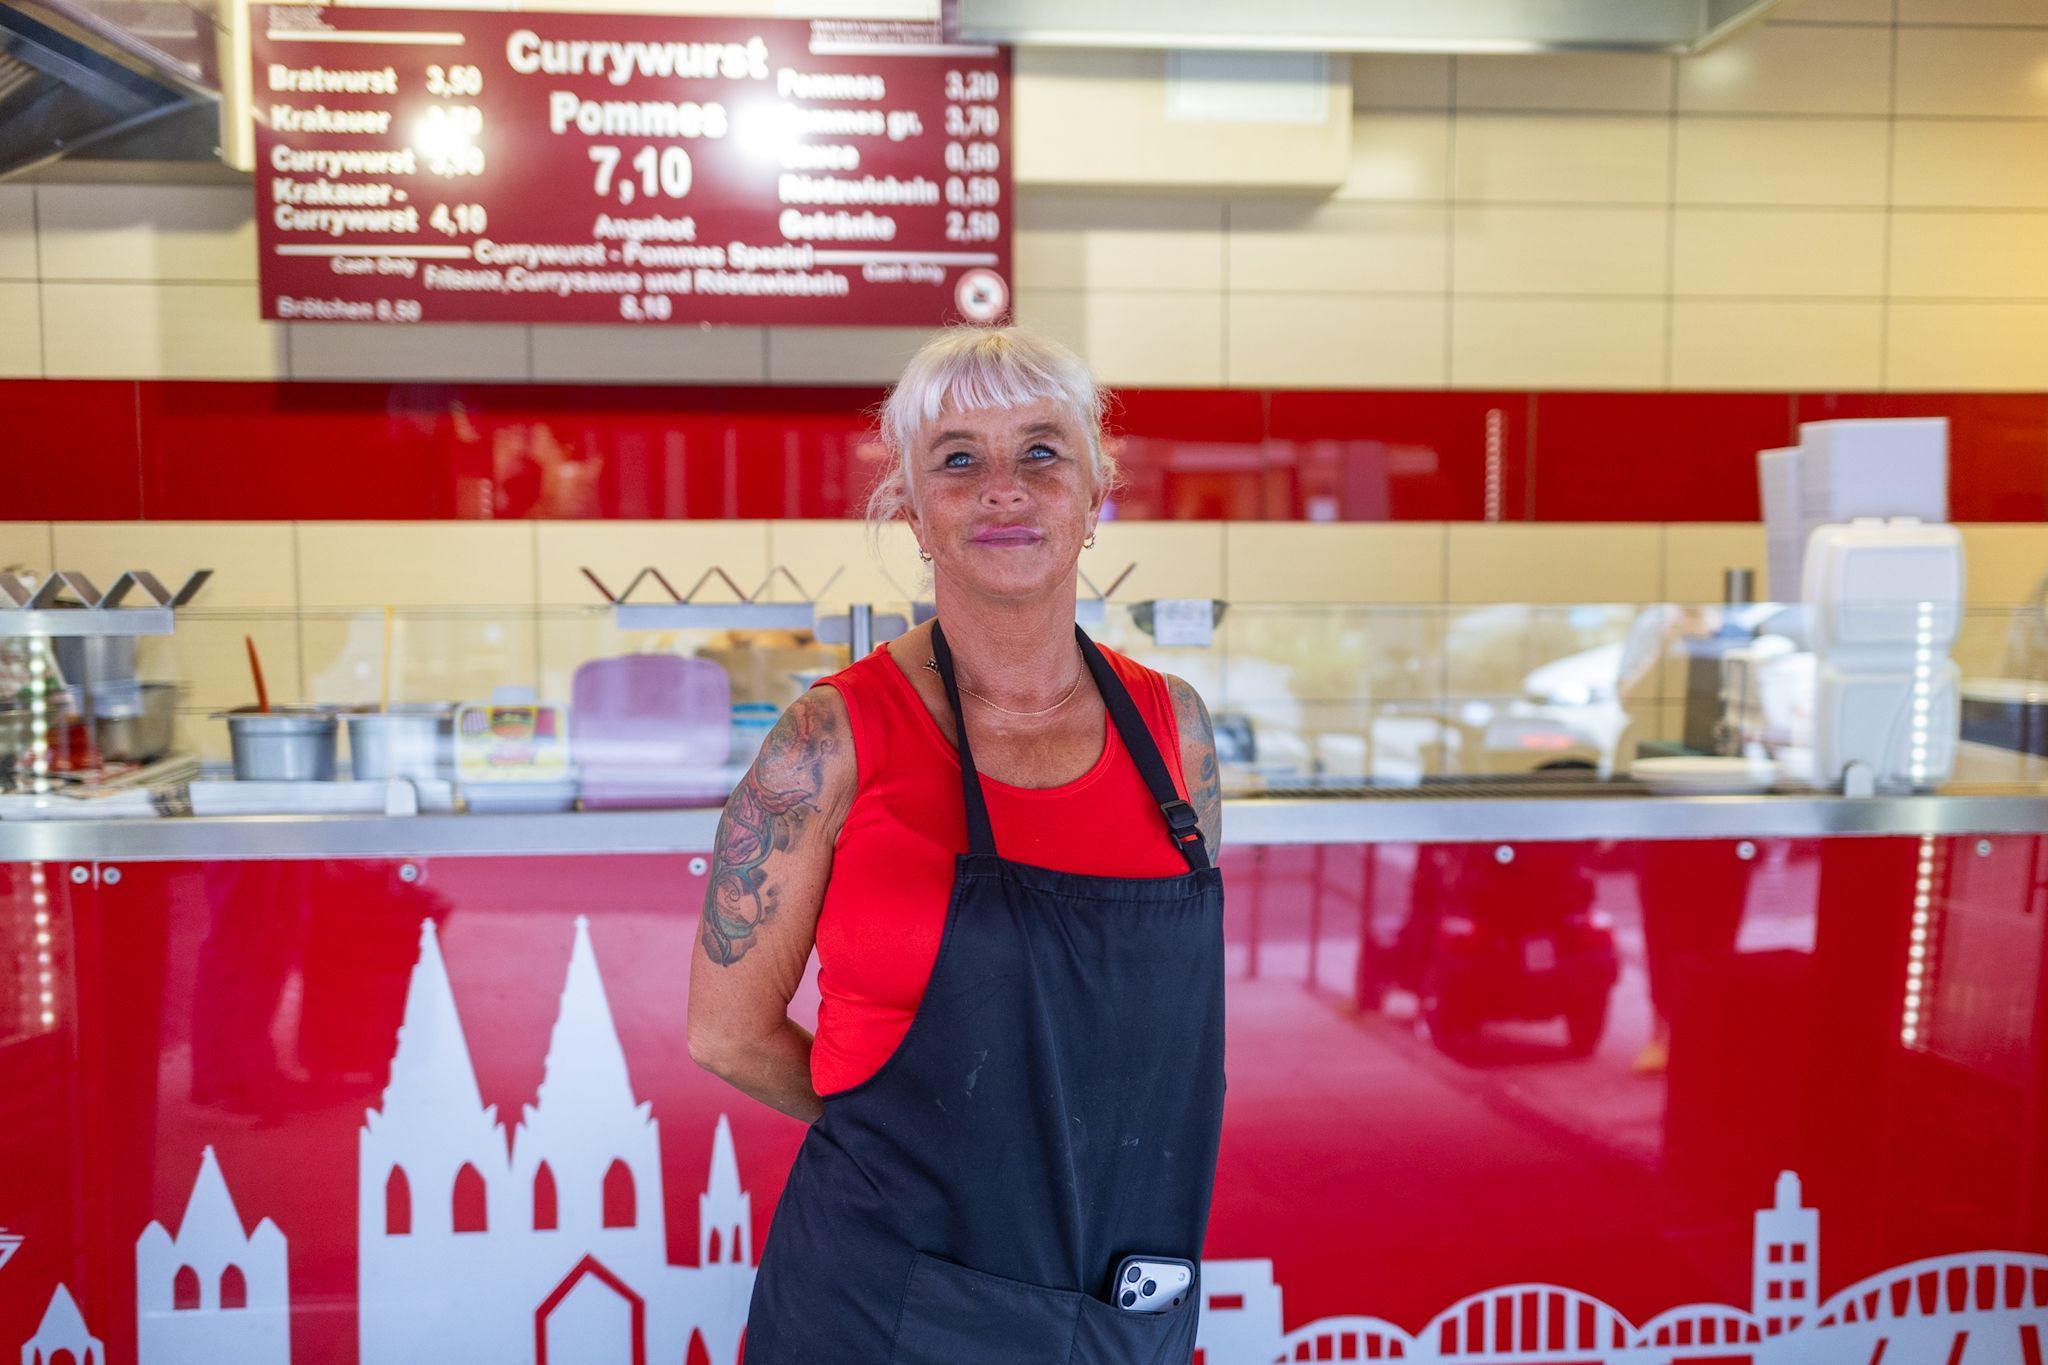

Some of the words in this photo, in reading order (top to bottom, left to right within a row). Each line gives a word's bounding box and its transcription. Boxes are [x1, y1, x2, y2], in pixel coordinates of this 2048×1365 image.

[506, 29, 769, 86] Currywurst
[269, 64, 398, 94] Bratwurst
[425, 65, 483, 98] 3,50
[777, 68, 885, 100] Pommes
[271, 104, 392, 134] Krakauer
[550, 90, 728, 138] Pommes
[887, 110, 923, 141] gr.
[945, 105, 999, 137] 3,70
[272, 145, 416, 178] Currywurst
[588, 145, 693, 205] 7,10
[274, 205, 419, 236] Currywurst
[430, 203, 487, 237] 4,10
[593, 213, 697, 243] Angebot
[473, 238, 607, 270] Currywurst
[622, 239, 726, 268] Pommes
[727, 240, 815, 272] Spezial
[644, 269, 693, 294] und
